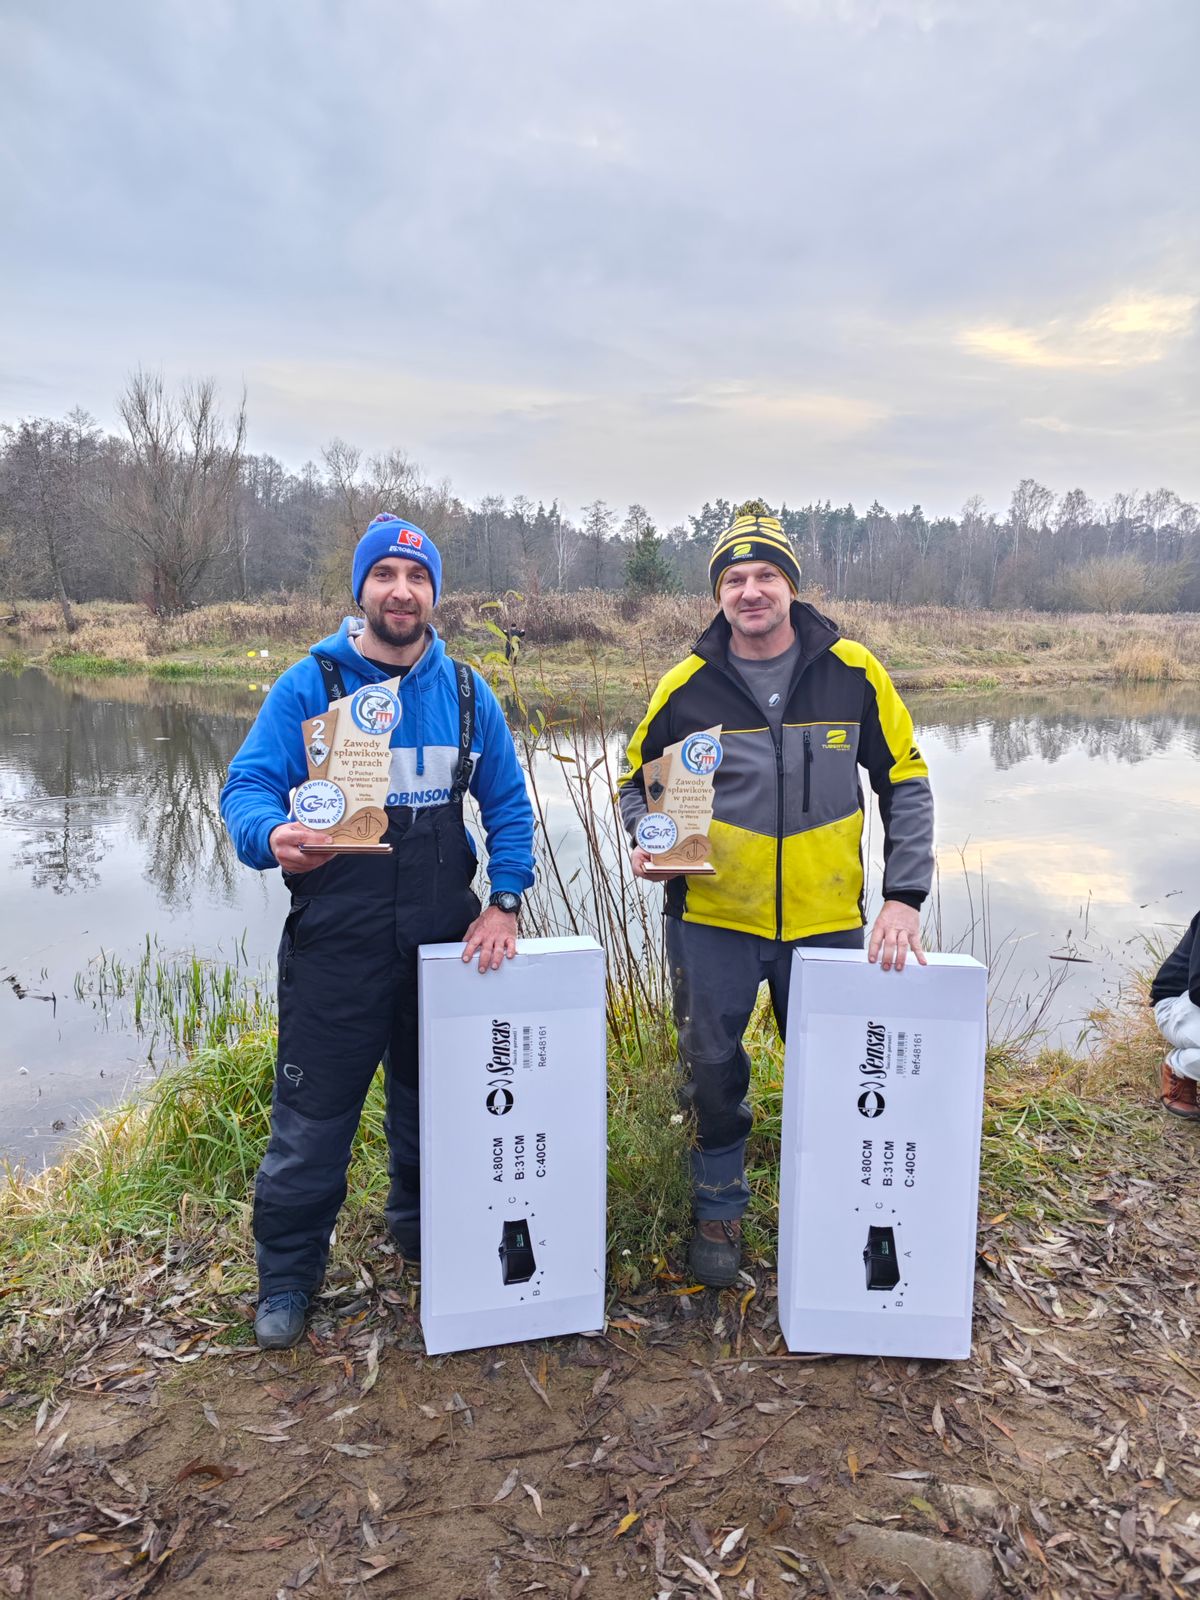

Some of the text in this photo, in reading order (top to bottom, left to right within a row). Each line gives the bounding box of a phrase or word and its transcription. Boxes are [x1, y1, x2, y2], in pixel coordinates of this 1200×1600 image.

[311, 719, 325, 739] 2
[343, 739, 381, 749] Zawody
[334, 749, 390, 759] spławikowe
[352, 760, 382, 769] parach
[652, 763, 661, 780] 2
[303, 781, 329, 791] Sportu
[668, 786, 713, 795] spławikowe
[675, 778, 706, 786] Zawody
[386, 788, 452, 806] OBINSON
[486, 1019, 514, 1076] Sensas
[538, 1026, 547, 1067] Ref:48161
[859, 1021, 887, 1079] Sensas
[912, 1033, 922, 1075] Ref:48161
[493, 1137, 503, 1182] A:80CM
[515, 1135, 525, 1180] B:31CM
[536, 1133, 546, 1178] C:40CM
[861, 1140, 872, 1186] A:80CM
[883, 1141, 894, 1186] B:31CM
[904, 1142, 916, 1188] C:40CM
[508, 1196, 516, 1204] C
[539, 1239, 546, 1247] A
[904, 1250, 912, 1258] A
